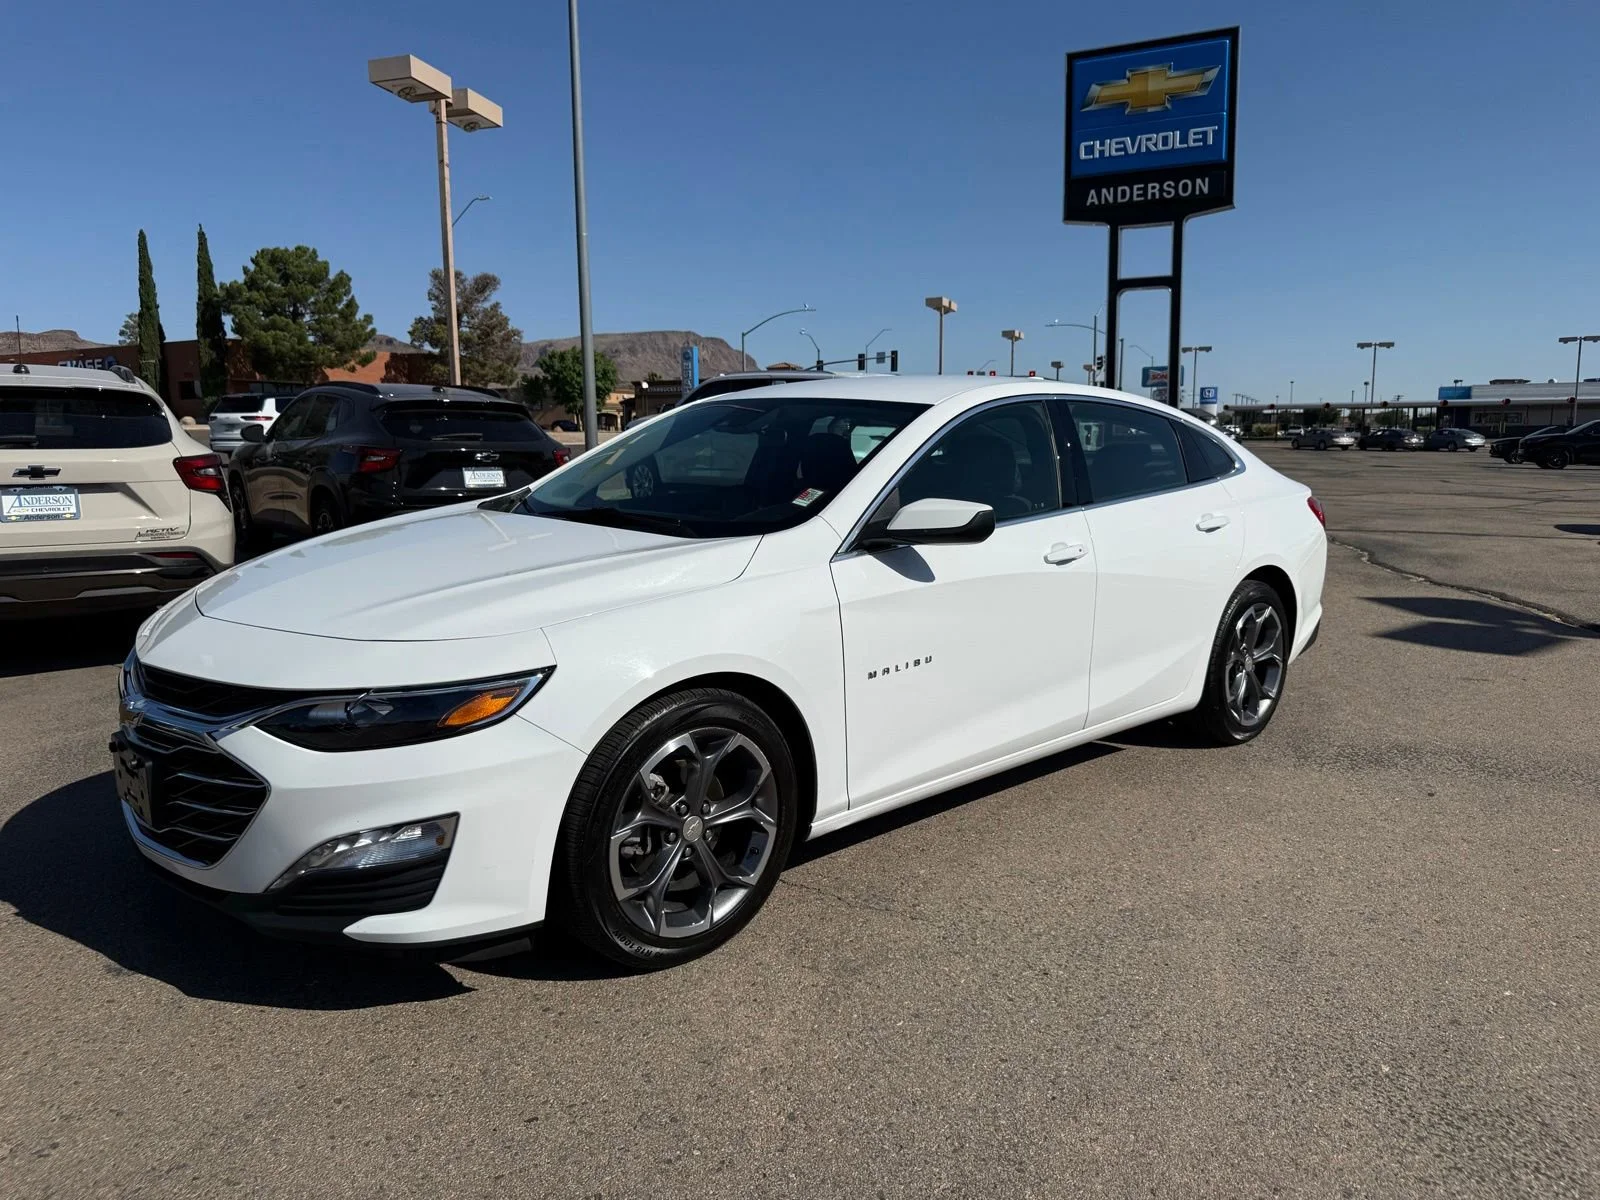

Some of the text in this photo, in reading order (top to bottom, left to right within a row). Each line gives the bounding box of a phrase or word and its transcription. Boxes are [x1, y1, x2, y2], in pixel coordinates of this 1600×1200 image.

[1079, 126, 1218, 160] CHEVROLET
[1086, 178, 1209, 206] ANDERSON
[6, 494, 74, 513] ANDERSON
[24, 513, 60, 521] Anderson
[867, 655, 933, 680] MALIBU
